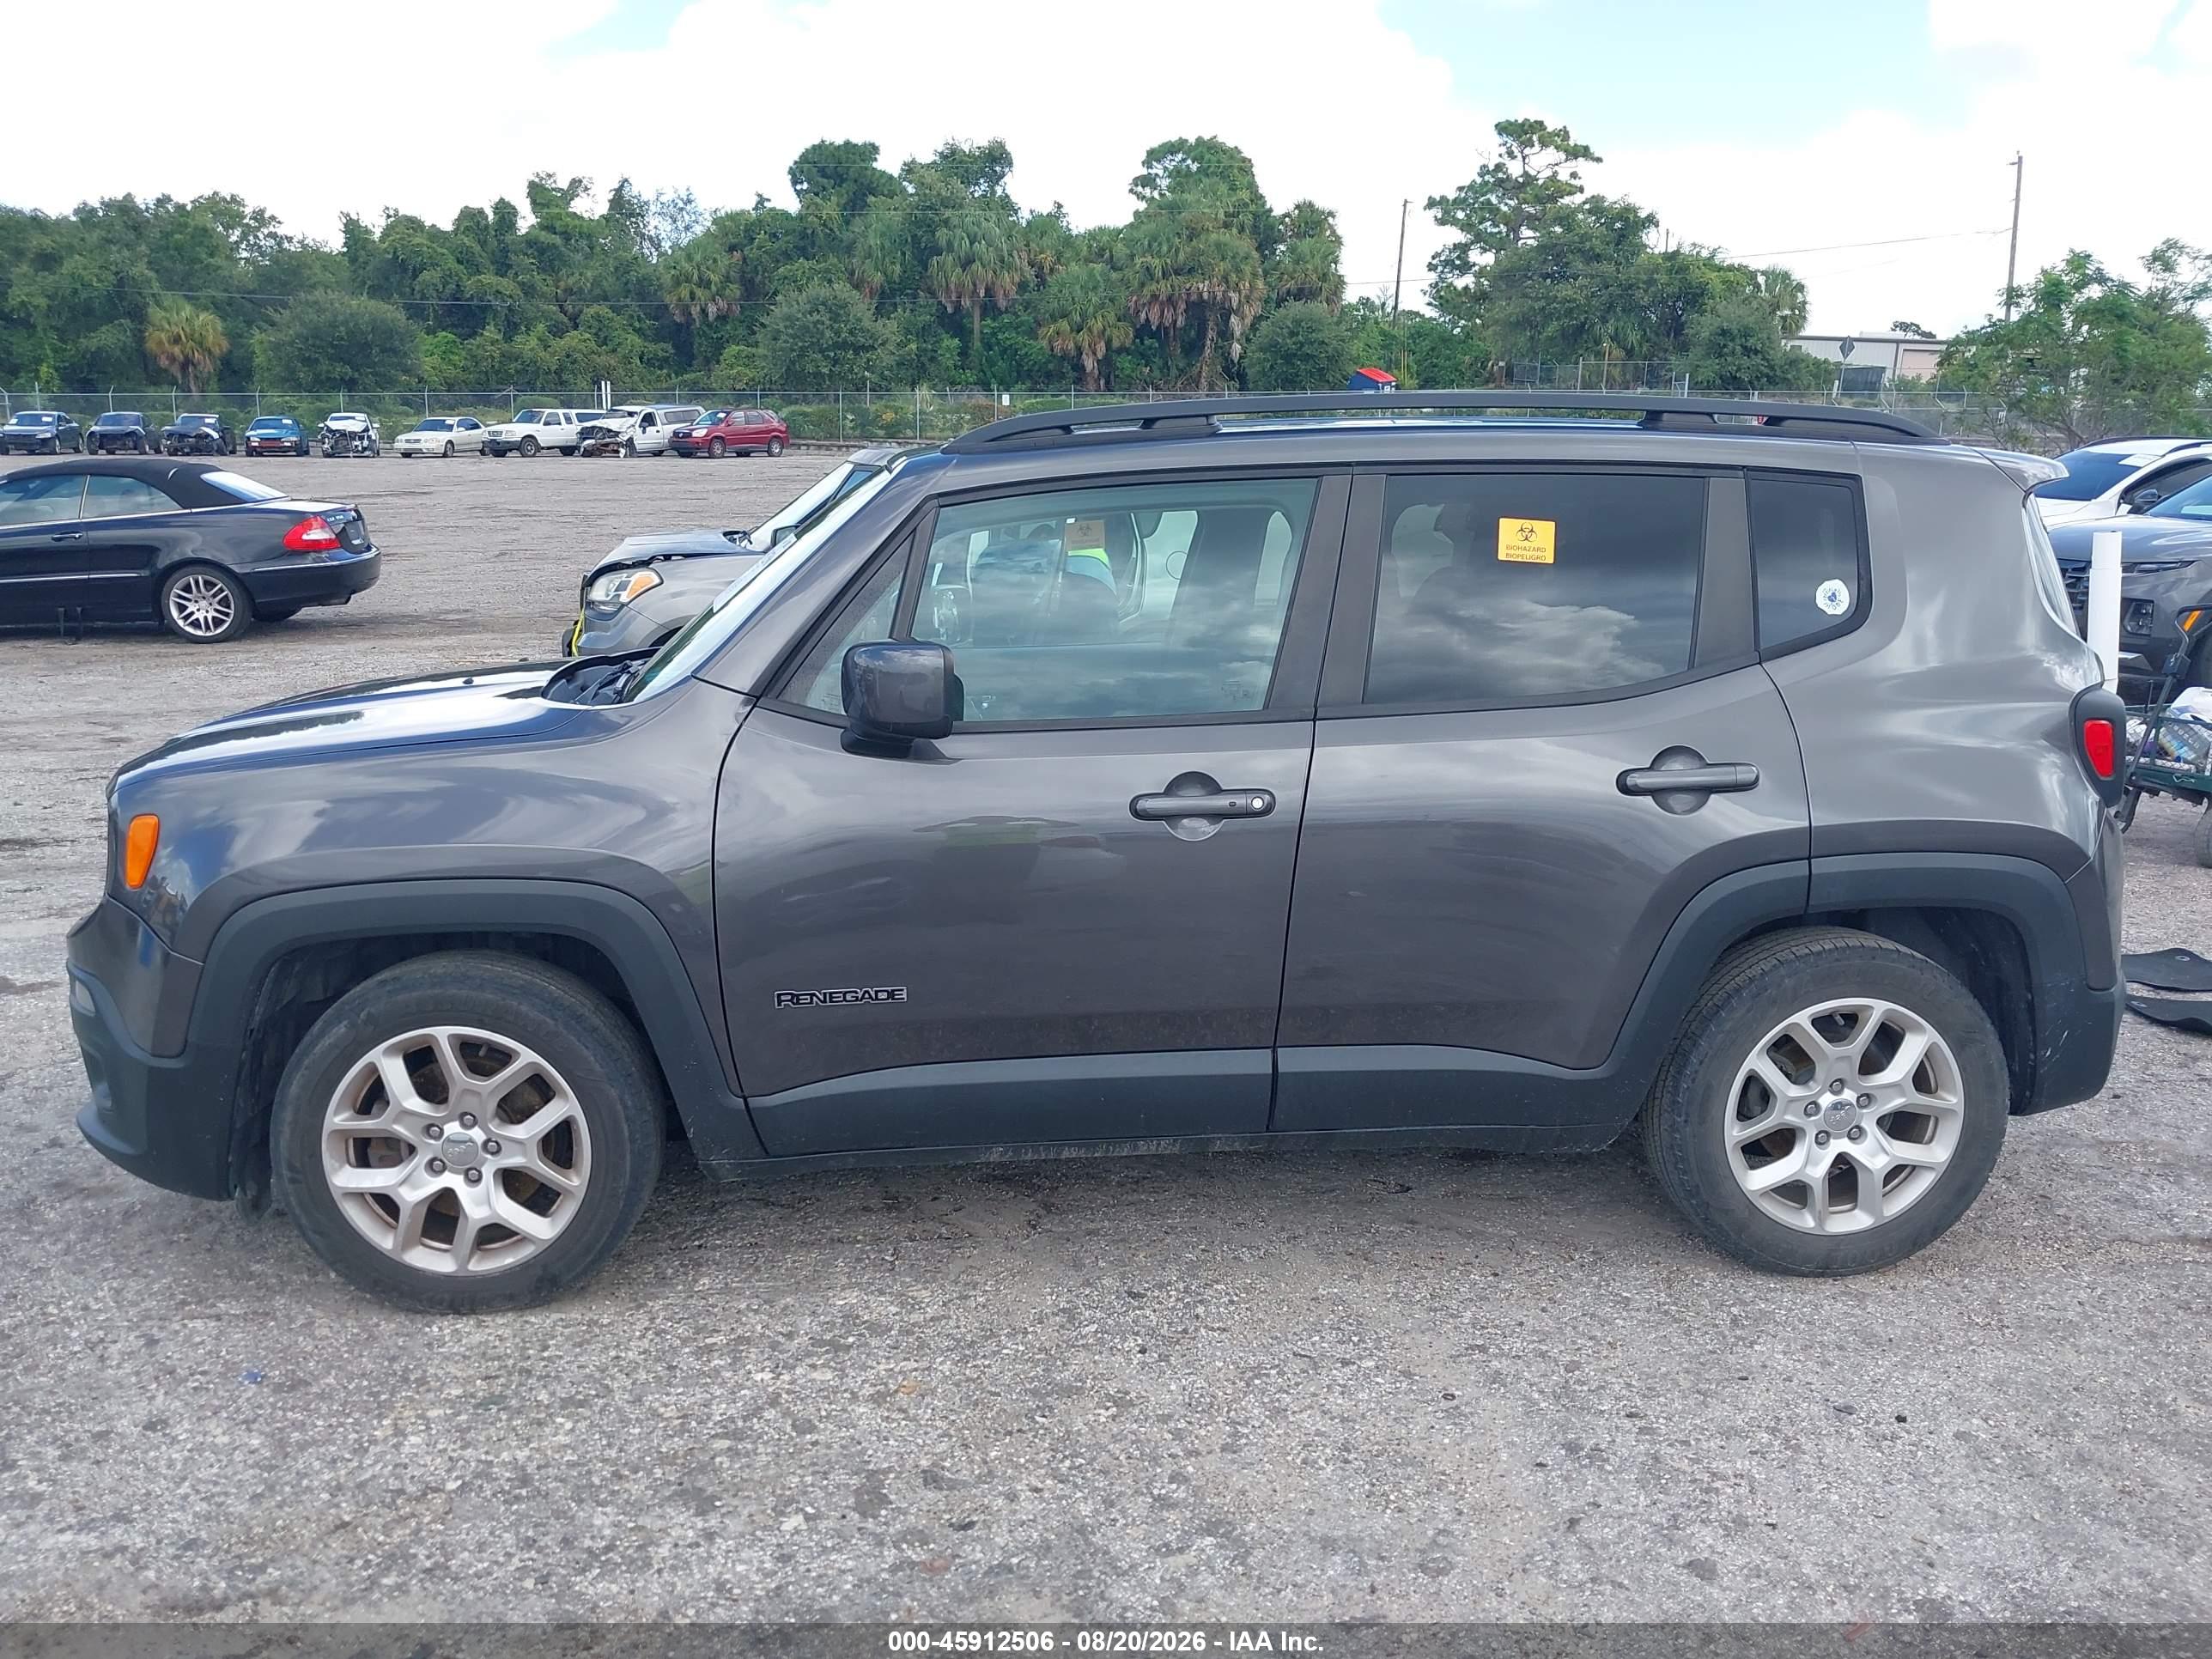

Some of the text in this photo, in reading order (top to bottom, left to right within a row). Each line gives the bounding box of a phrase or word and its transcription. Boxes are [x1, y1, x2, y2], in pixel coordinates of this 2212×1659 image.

[1505, 544, 1547, 553] BIOHAZARD
[1505, 552, 1547, 562] BIOPELIGRO
[775, 987, 908, 1009] RENEGADE
